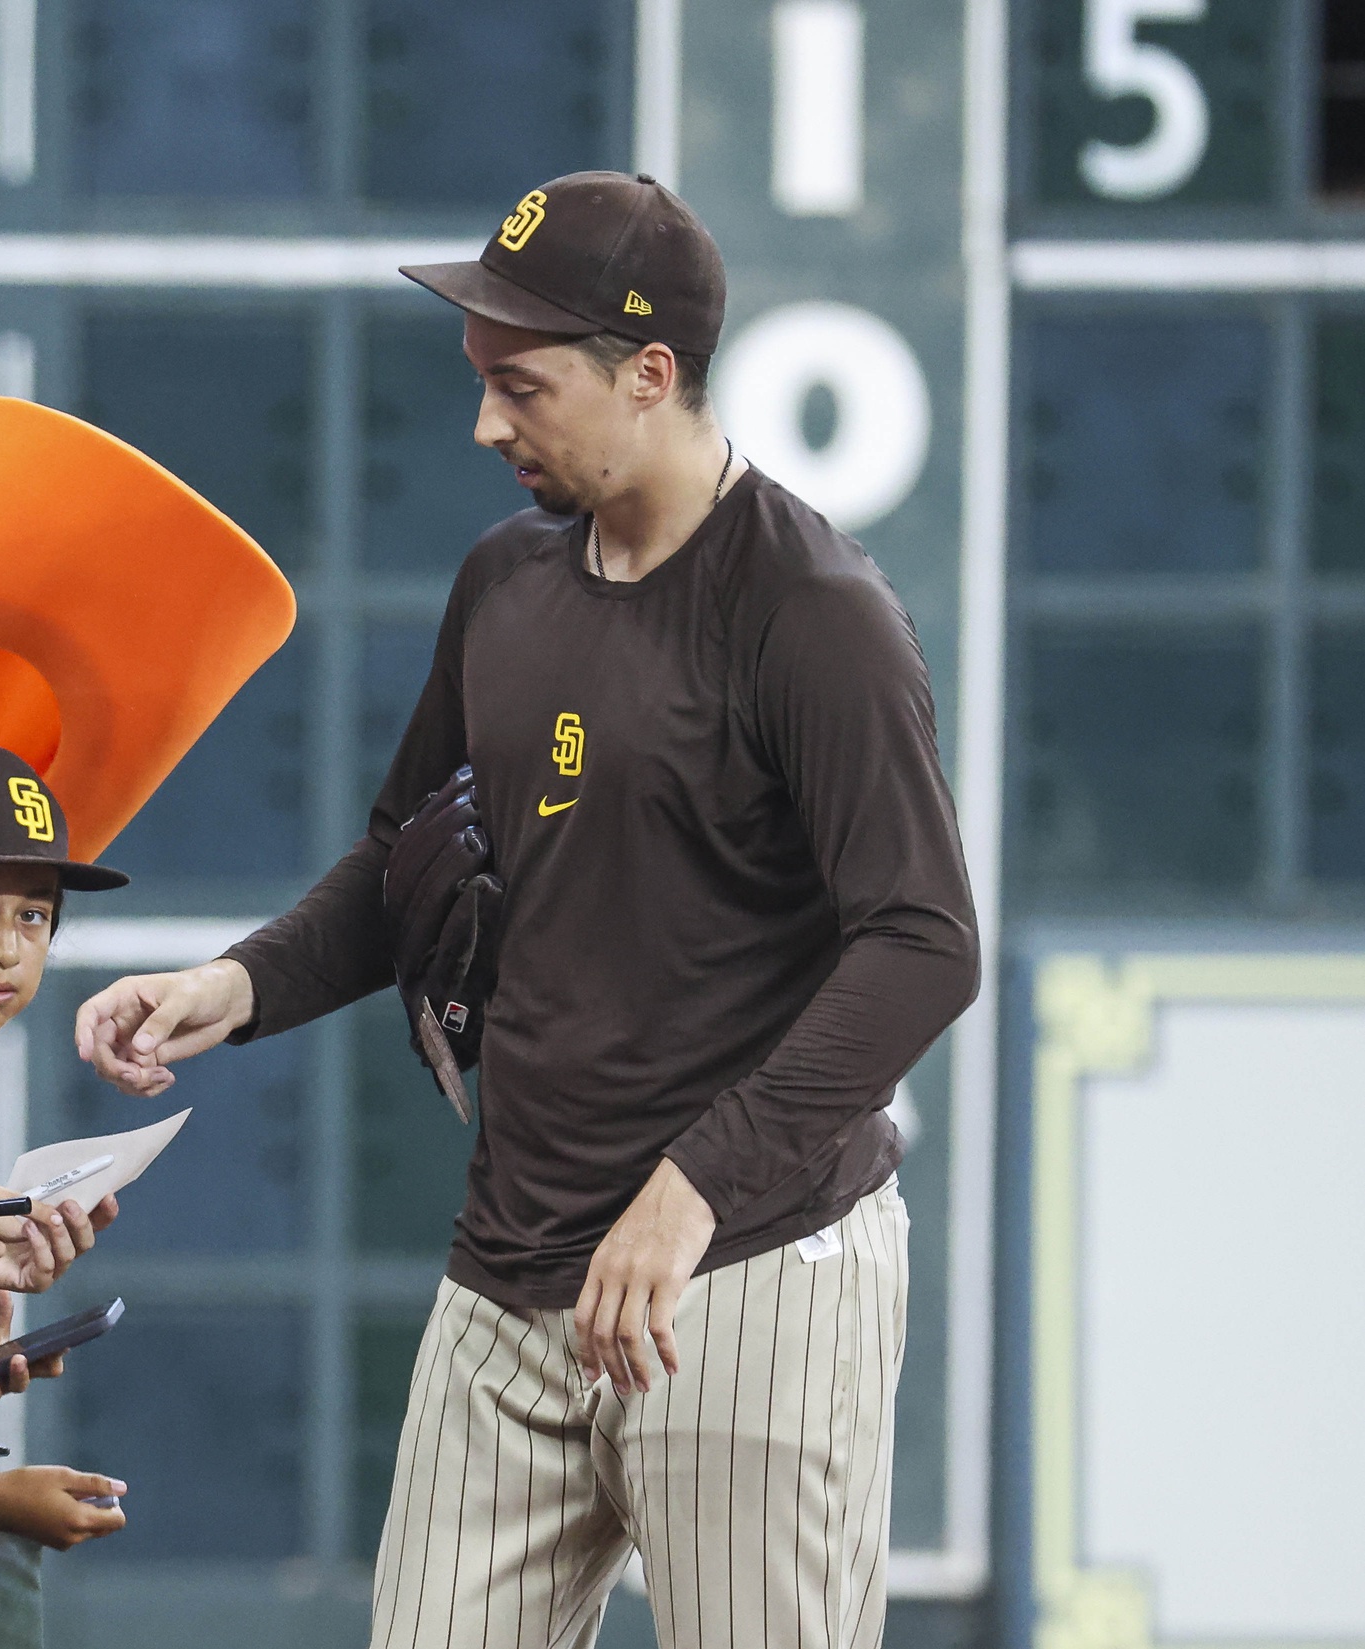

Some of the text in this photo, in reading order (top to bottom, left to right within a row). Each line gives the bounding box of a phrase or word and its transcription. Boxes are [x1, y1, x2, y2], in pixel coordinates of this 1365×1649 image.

[1077, 0, 1210, 201] 5
[498, 189, 548, 252] SD
[552, 712, 585, 777] SD
[7, 776, 55, 843] SD
